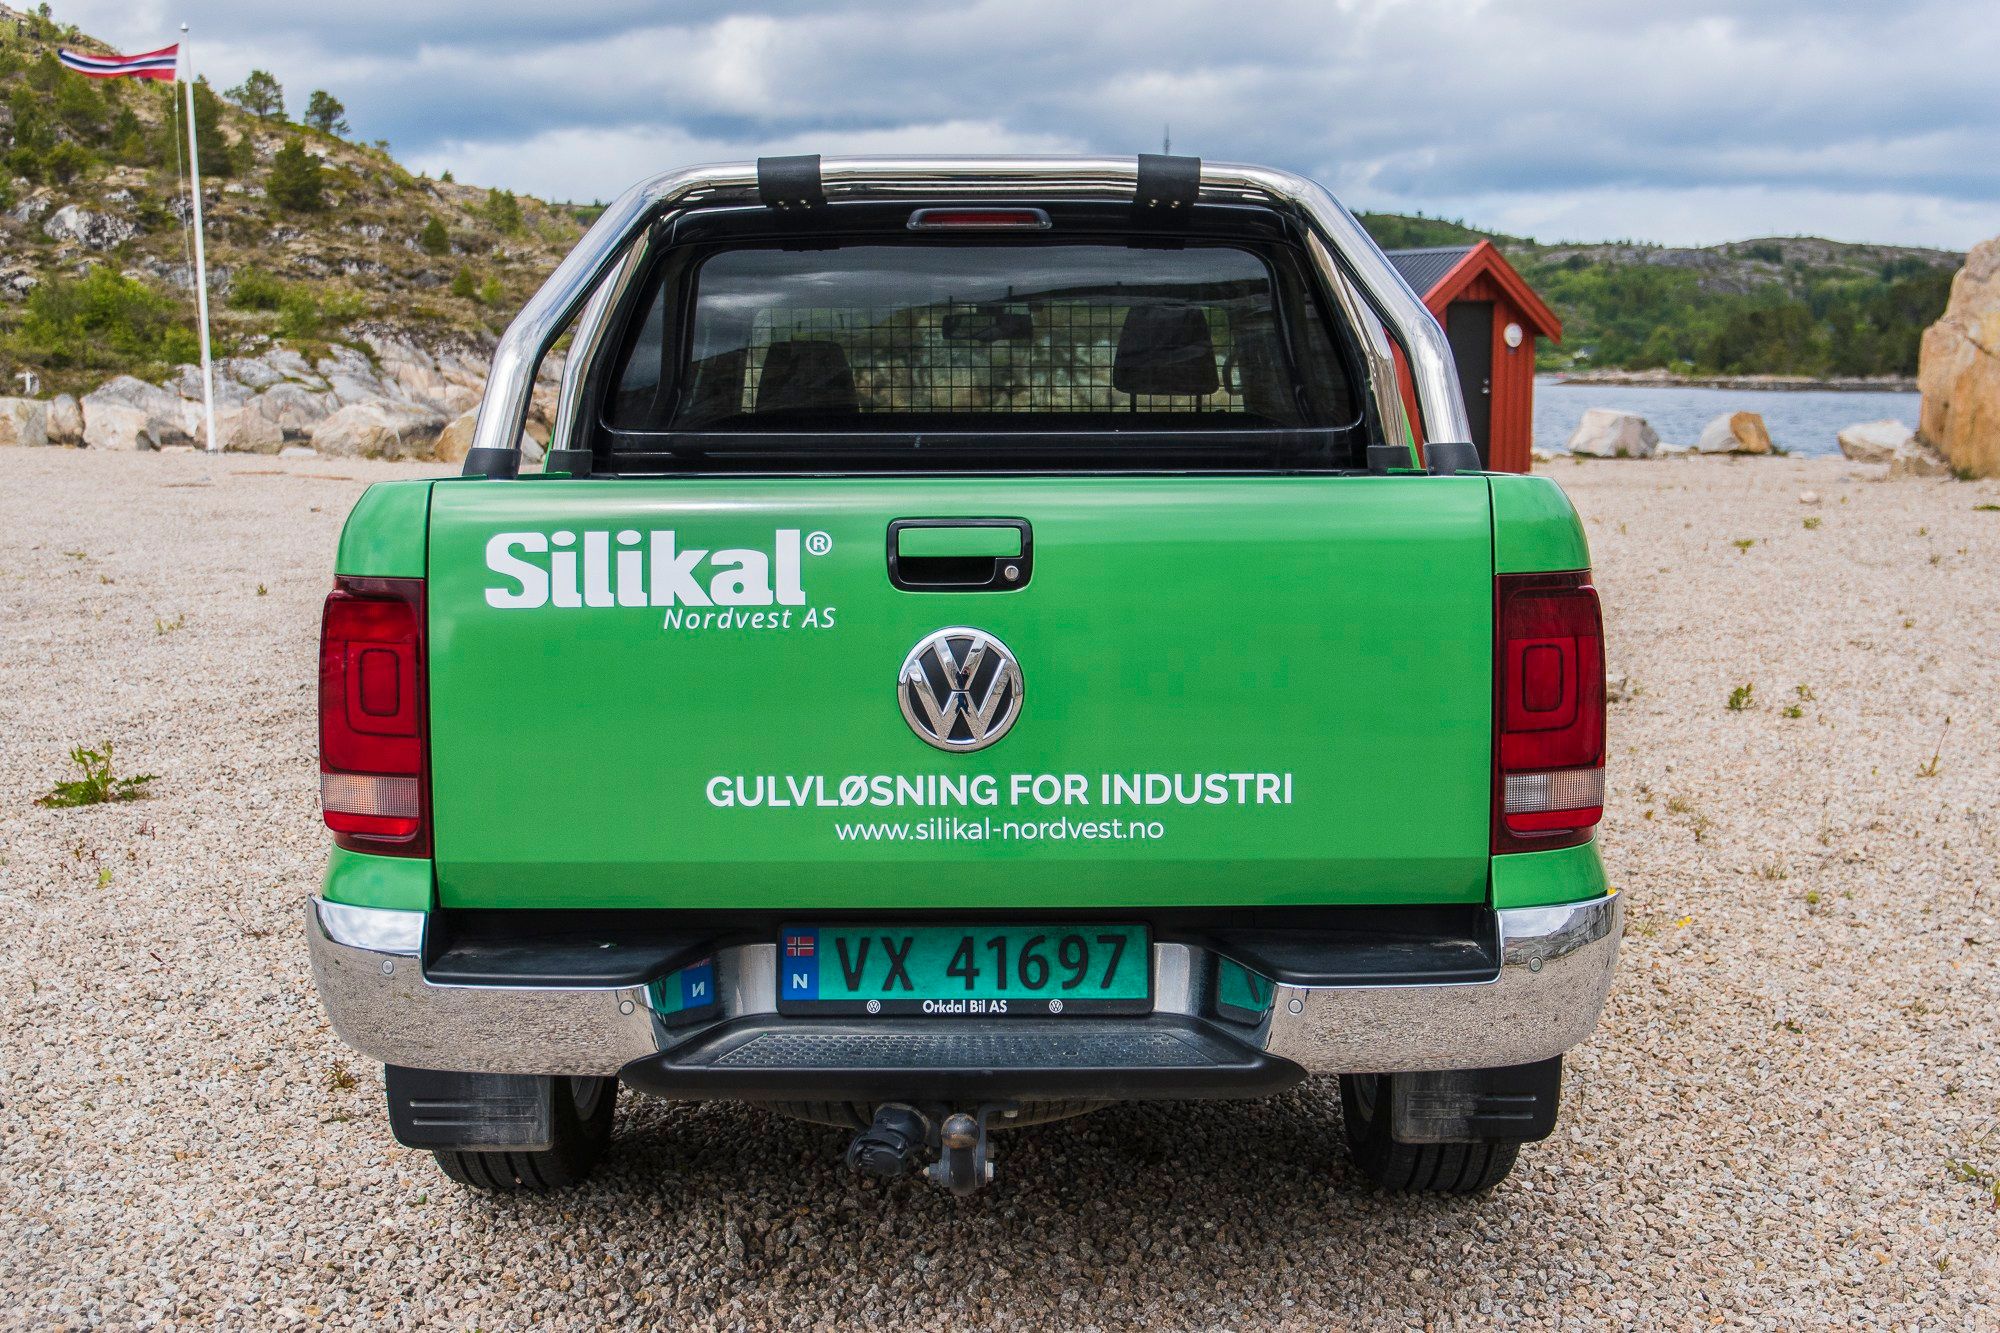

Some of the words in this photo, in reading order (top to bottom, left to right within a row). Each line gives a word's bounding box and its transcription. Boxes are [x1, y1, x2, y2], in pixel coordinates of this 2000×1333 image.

[663, 607, 792, 630] Nordvest
[802, 606, 837, 629] AS
[705, 775, 998, 808] GULVLØSNING
[1011, 774, 1090, 805] FOR
[1102, 773, 1293, 804] INDUSTRI
[835, 817, 1164, 841] www.silikal-nordvest.no
[836, 936, 914, 991] VX
[945, 934, 1129, 989] 41697
[792, 973, 808, 989] N
[922, 999, 966, 1014] Orkdal
[970, 999, 986, 1014] Bil
[989, 999, 1008, 1014] AS
